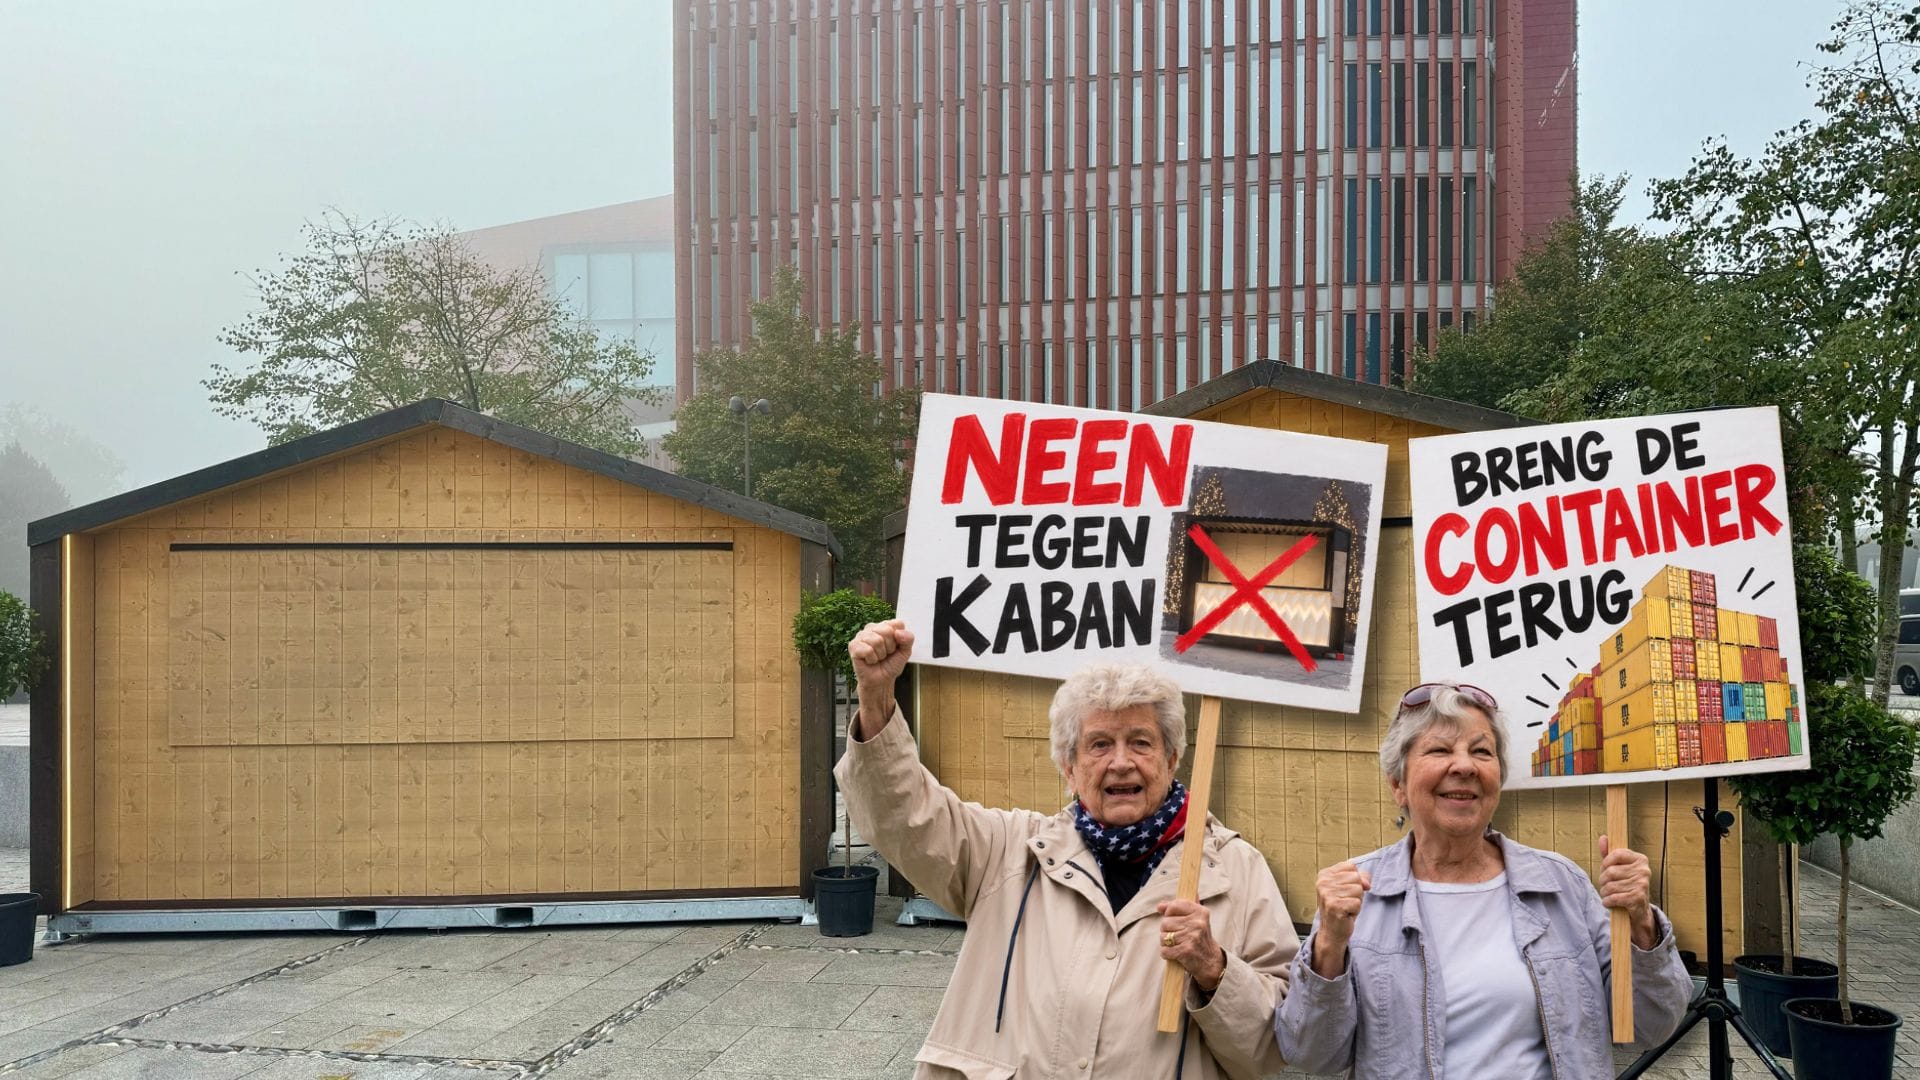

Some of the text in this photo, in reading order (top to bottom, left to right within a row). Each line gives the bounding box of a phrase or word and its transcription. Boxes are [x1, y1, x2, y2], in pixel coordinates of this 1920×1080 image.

[941, 413, 1194, 507] NEEN
[1450, 421, 1706, 507] BRENG DE
[955, 514, 1151, 570] TEGEN
[1424, 464, 1783, 596] CONTAINER
[932, 573, 1156, 659] KABAN
[1433, 569, 1633, 668] TERUG
